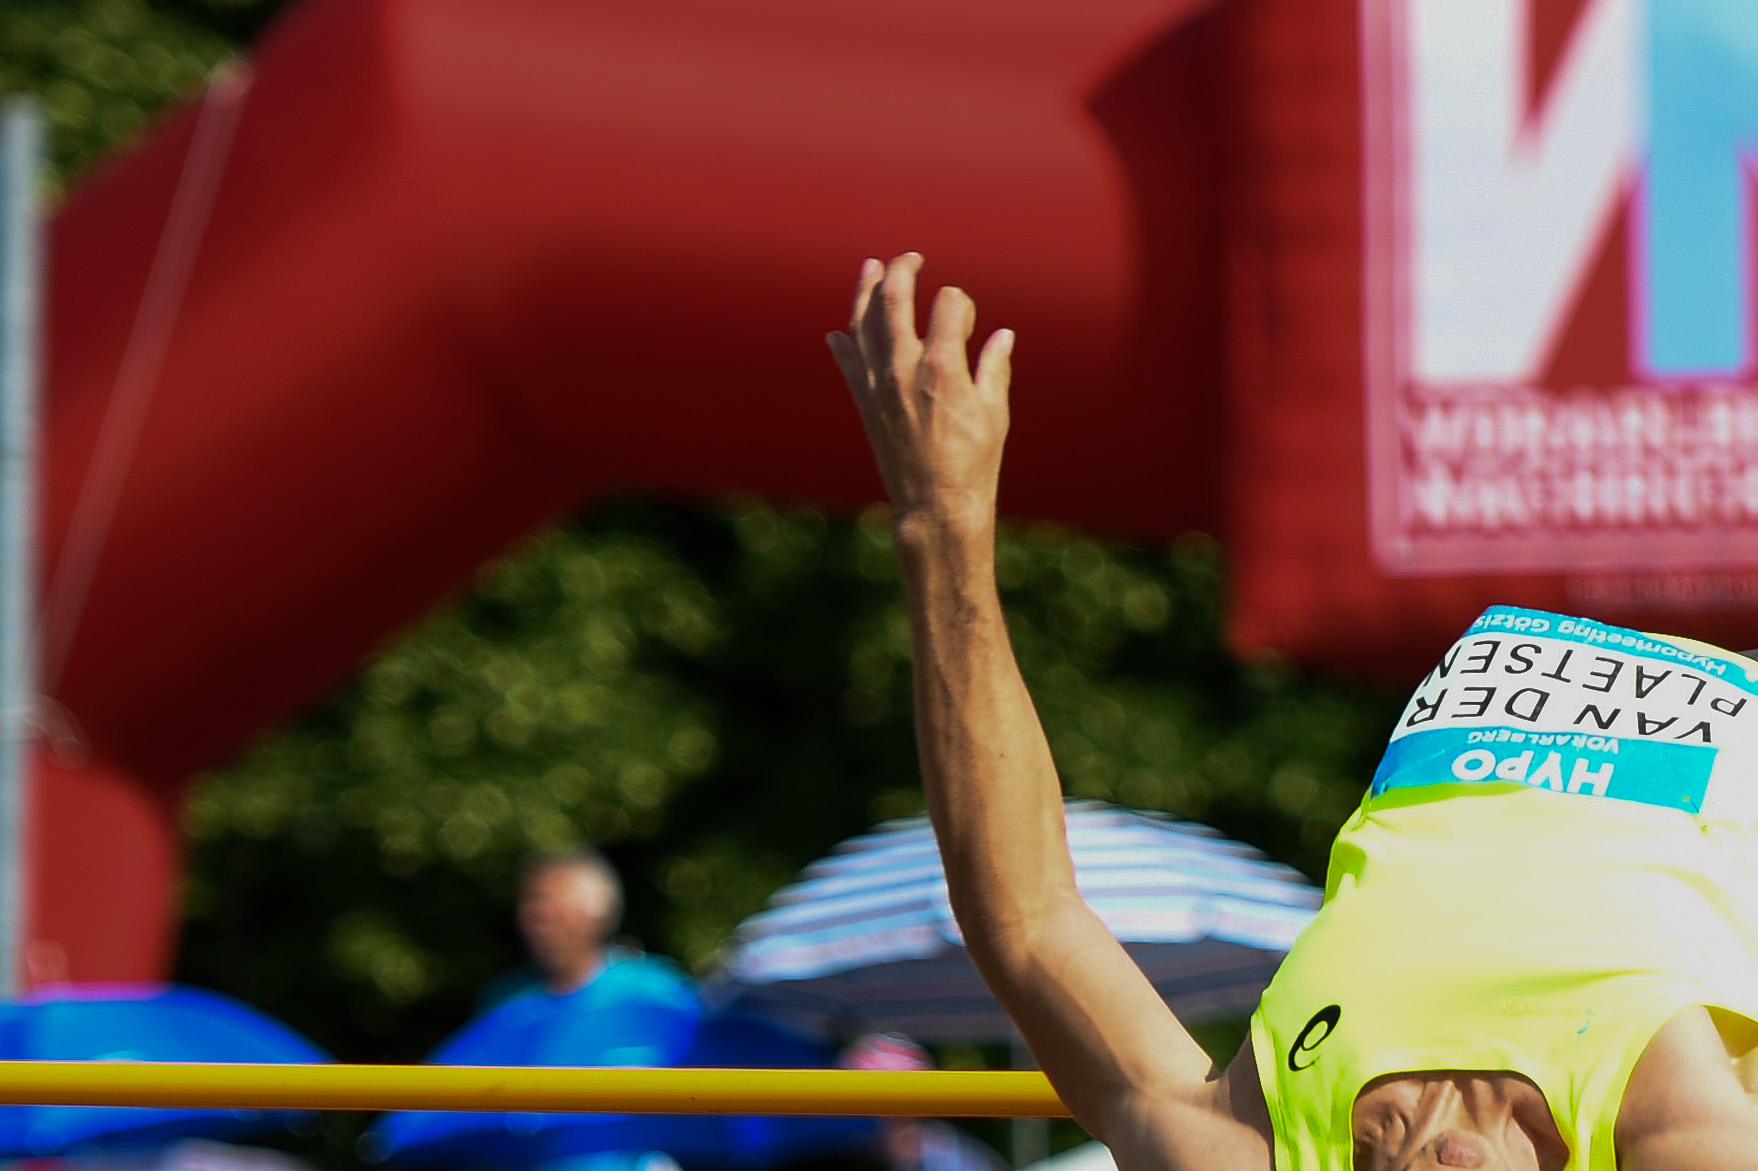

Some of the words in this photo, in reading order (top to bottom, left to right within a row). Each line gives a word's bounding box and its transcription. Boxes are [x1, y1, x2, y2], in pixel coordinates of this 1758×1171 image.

[1557, 619, 1728, 675] Hypomeeting
[1422, 640, 1748, 718] PLAETSEN
[1406, 686, 1551, 728] DER
[1573, 694, 1712, 743] VAN
[1468, 729, 1620, 754] VORARLBERG
[1451, 748, 1615, 797] HYPO
